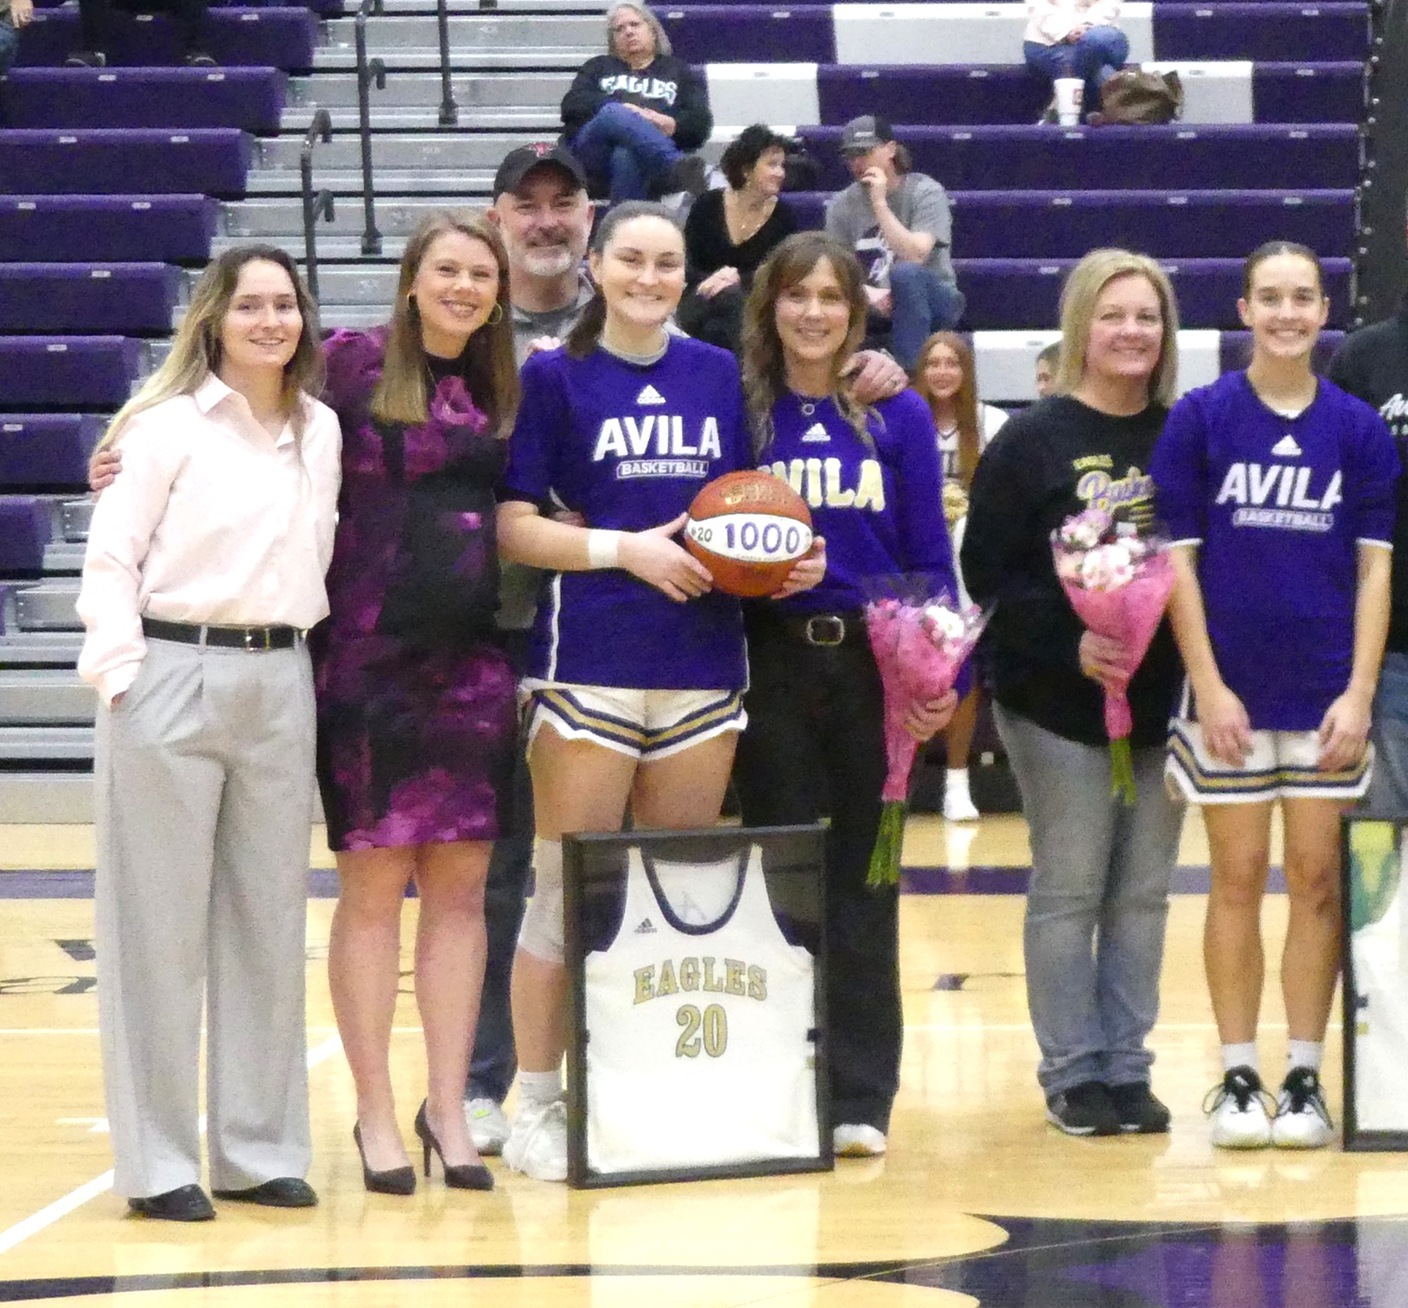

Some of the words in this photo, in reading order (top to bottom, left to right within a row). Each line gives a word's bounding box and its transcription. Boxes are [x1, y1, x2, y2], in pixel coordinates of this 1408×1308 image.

[600, 75, 678, 105] EAGLES
[592, 415, 722, 461] AVILA
[620, 461, 707, 476] BASKETBALL
[757, 457, 886, 512] VILA
[1215, 462, 1343, 511] AVILA
[725, 521, 800, 554] 1000
[633, 956, 768, 1006] EAGLES
[675, 1003, 728, 1059] 20
